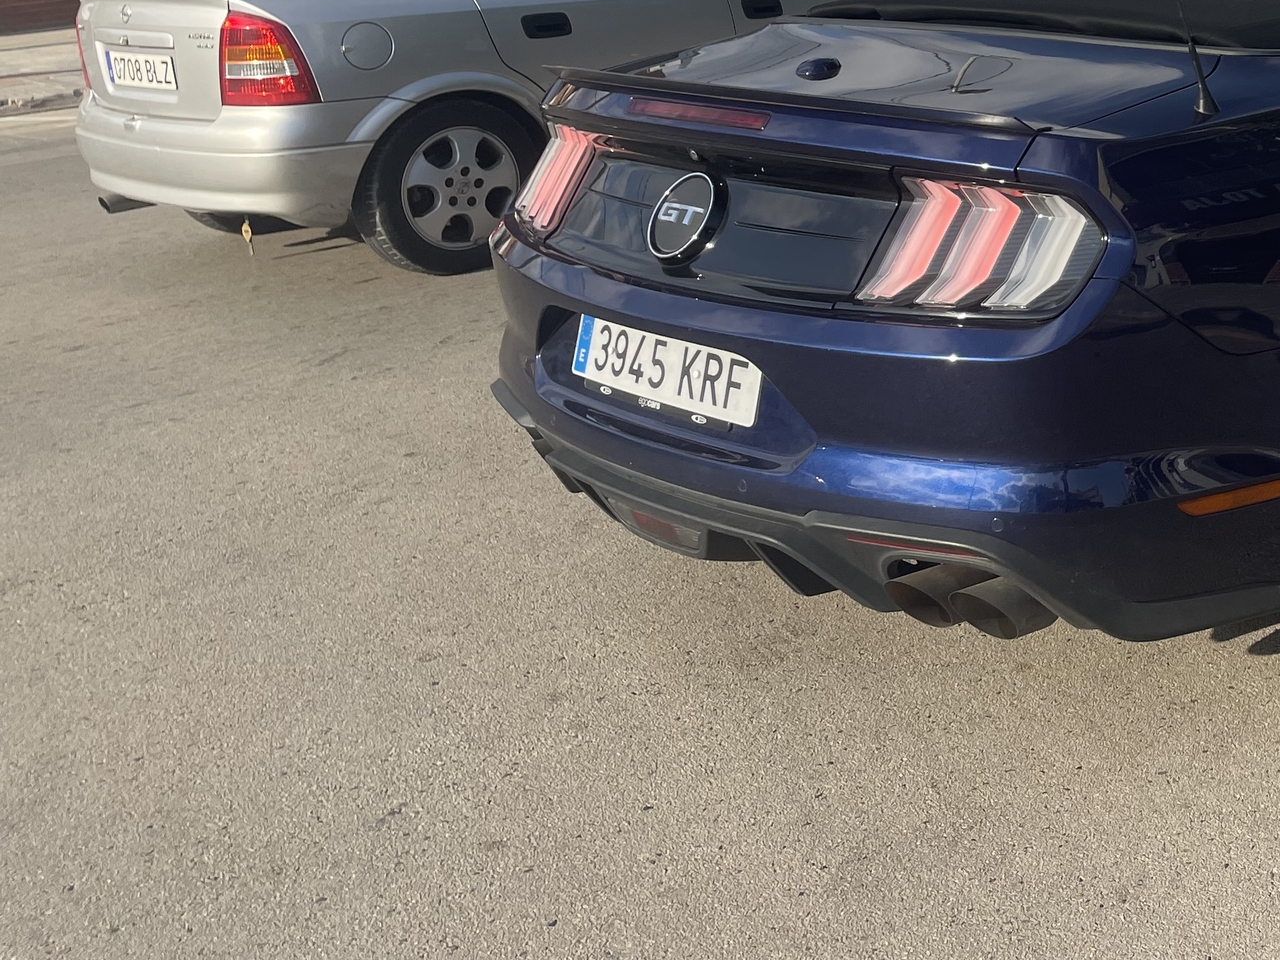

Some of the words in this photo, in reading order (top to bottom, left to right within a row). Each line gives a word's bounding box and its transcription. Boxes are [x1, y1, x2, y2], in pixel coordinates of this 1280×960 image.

[145, 59, 172, 84] BLZ
[658, 202, 705, 226] GT
[578, 348, 587, 362] E
[594, 324, 668, 389] 3945
[677, 346, 750, 409] KRF
